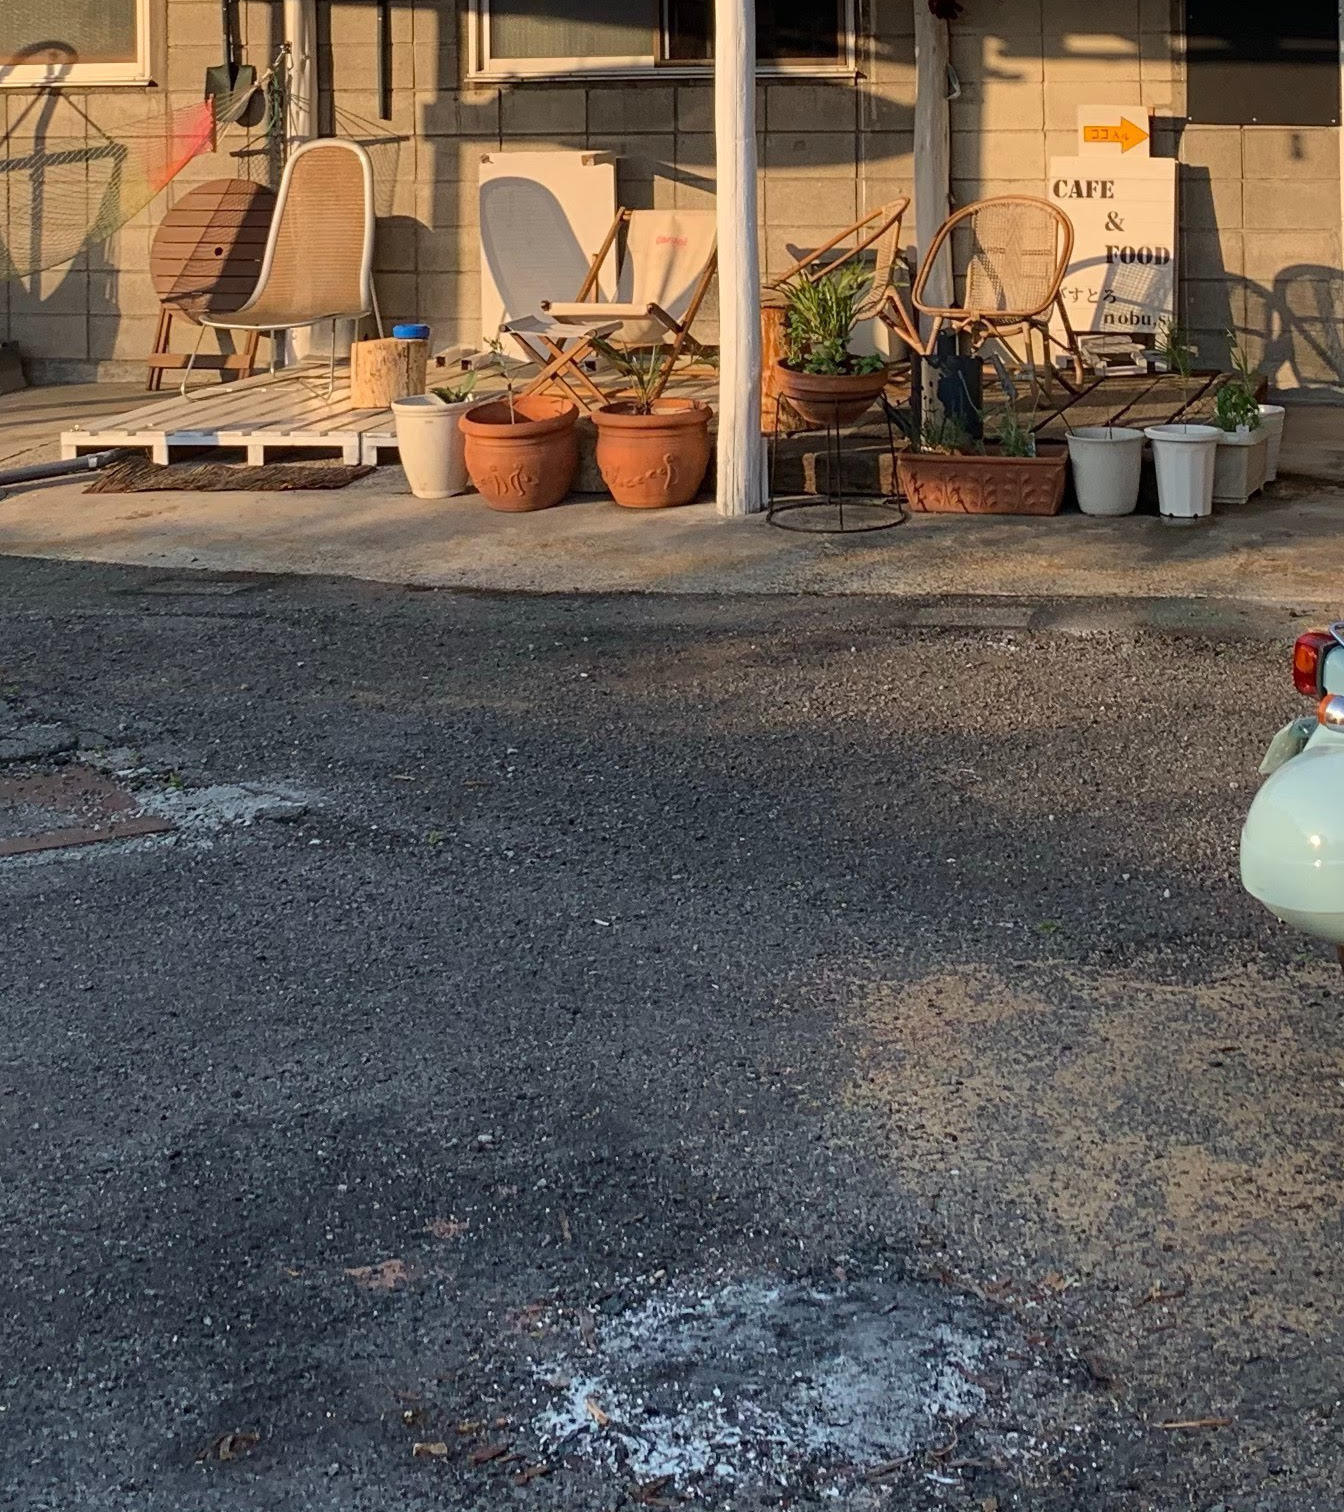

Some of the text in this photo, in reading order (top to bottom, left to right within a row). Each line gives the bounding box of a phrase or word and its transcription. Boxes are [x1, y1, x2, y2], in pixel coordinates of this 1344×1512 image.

[1052, 179, 1115, 199] CAFE
[1104, 210, 1126, 232] &
[1105, 245, 1171, 265] FOOD
